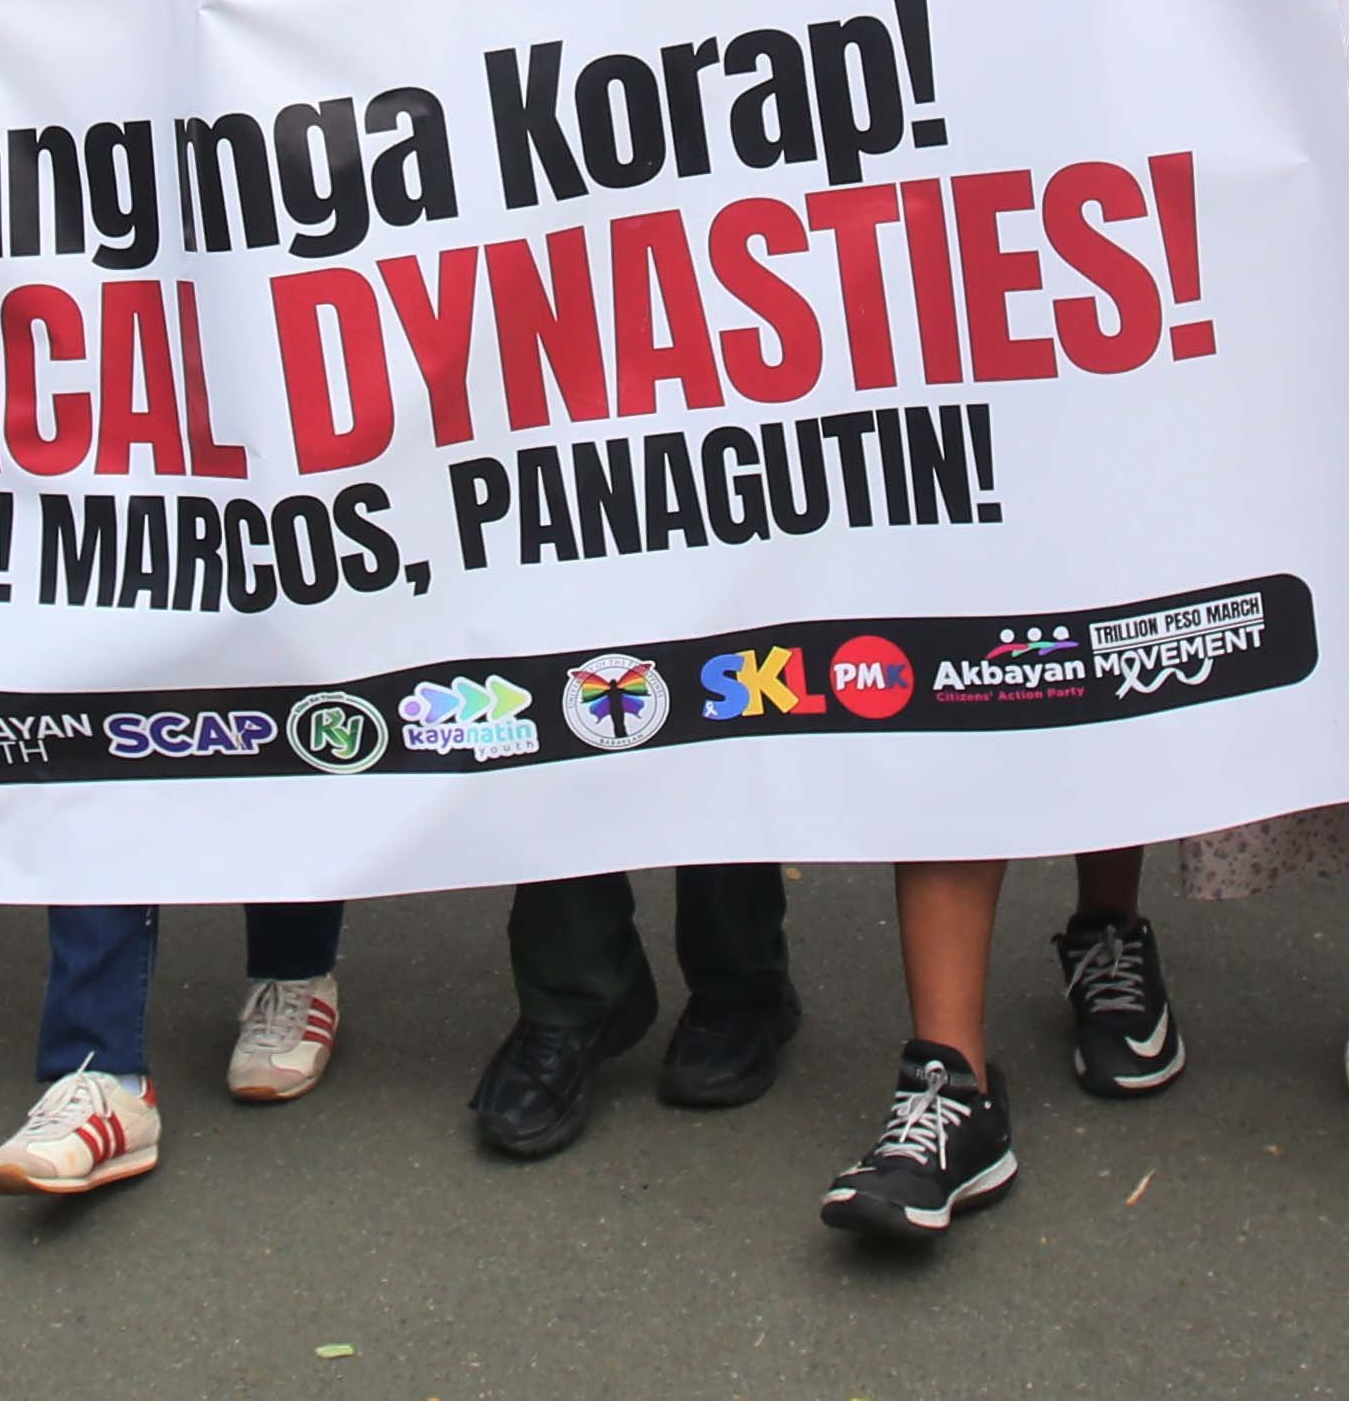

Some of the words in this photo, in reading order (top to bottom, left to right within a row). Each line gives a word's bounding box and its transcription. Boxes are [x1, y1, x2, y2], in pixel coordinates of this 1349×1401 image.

[174, 85, 459, 259] mga
[270, 150, 1217, 475] DYNASTIES!
[38, 480, 431, 615] MARCOS,
[451, 403, 1004, 571] PANAGUTIN!
[1093, 614, 1159, 646] TRILLION
[1164, 610, 1202, 635] PESO
[1205, 597, 1261, 626] MARCH
[933, 657, 1086, 693] Akbayan
[1094, 624, 1265, 678] MOVEMENT
[700, 646, 827, 721] SKL
[832, 661, 909, 693] PMK
[936, 689, 994, 702] Citizens'
[998, 688, 1044, 700] Action
[1046, 685, 1085, 700] Party
[103, 711, 278, 758] SCAP
[407, 720, 533, 754] kayanatin
[478, 741, 535, 757] youth
